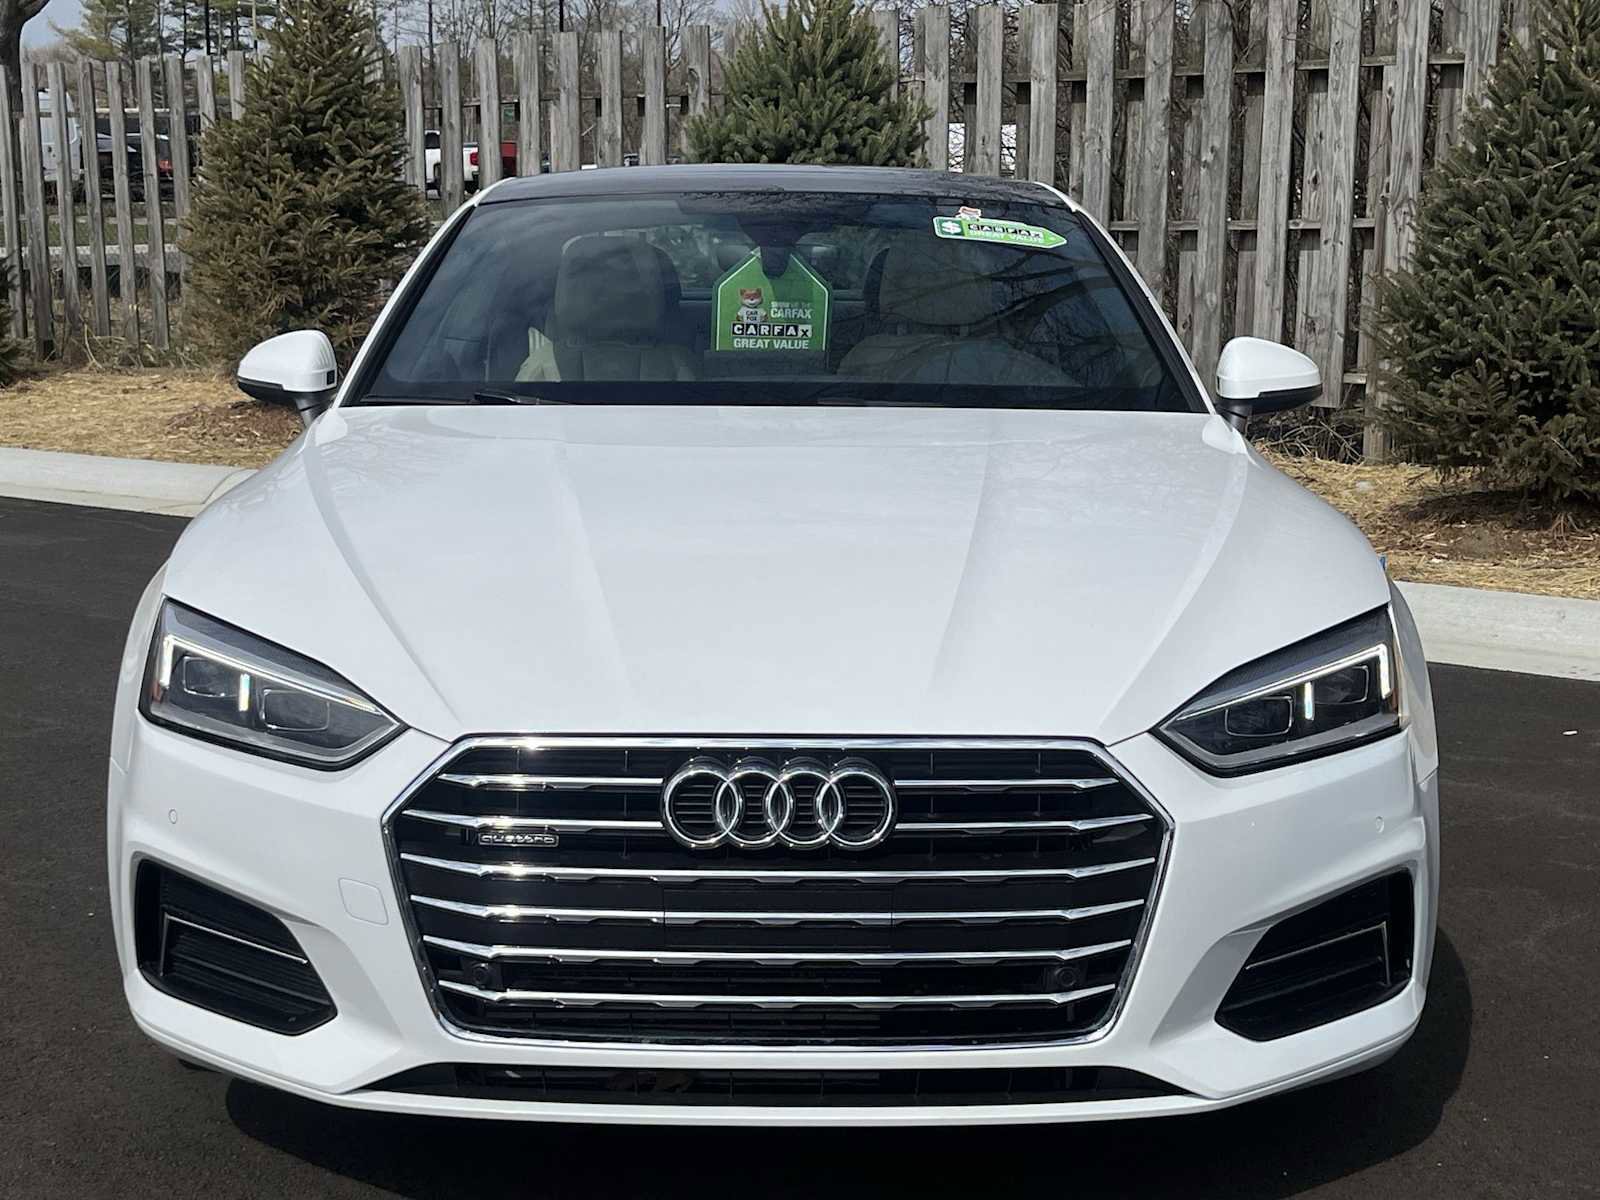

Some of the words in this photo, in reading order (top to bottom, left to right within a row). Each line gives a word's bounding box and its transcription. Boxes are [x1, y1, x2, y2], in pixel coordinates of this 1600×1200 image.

[770, 308, 812, 319] CARFAX
[732, 323, 811, 338] CARFAX
[733, 338, 770, 348] GREAT
[773, 339, 809, 349] VALUE
[481, 834, 556, 845] quattro
